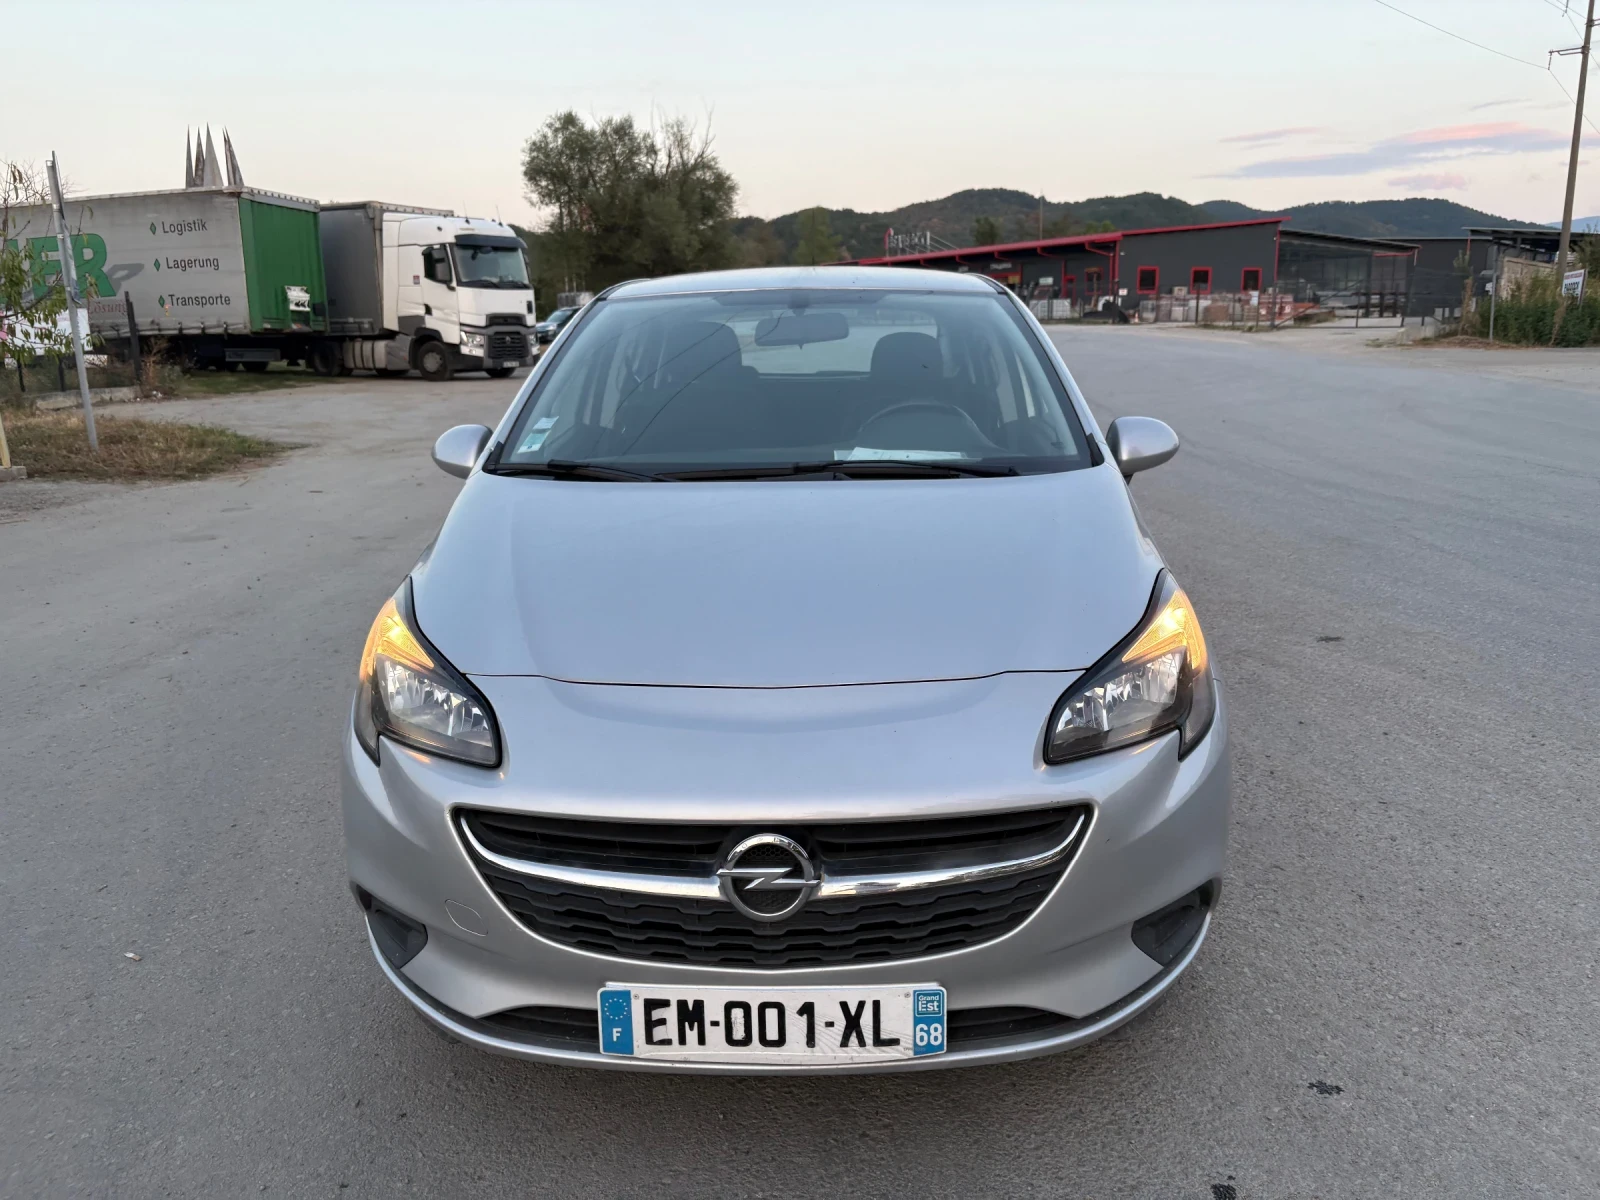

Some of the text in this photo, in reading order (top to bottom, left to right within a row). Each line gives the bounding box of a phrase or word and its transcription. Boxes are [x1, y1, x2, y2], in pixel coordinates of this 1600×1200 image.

[162, 218, 207, 235] Logistik
[166, 256, 220, 271] Lagerung
[168, 293, 231, 308] Transporte
[919, 1000, 940, 1012] Est
[643, 998, 901, 1049] EM-001-XL
[612, 1028, 622, 1042] F
[915, 1023, 943, 1047] 68
